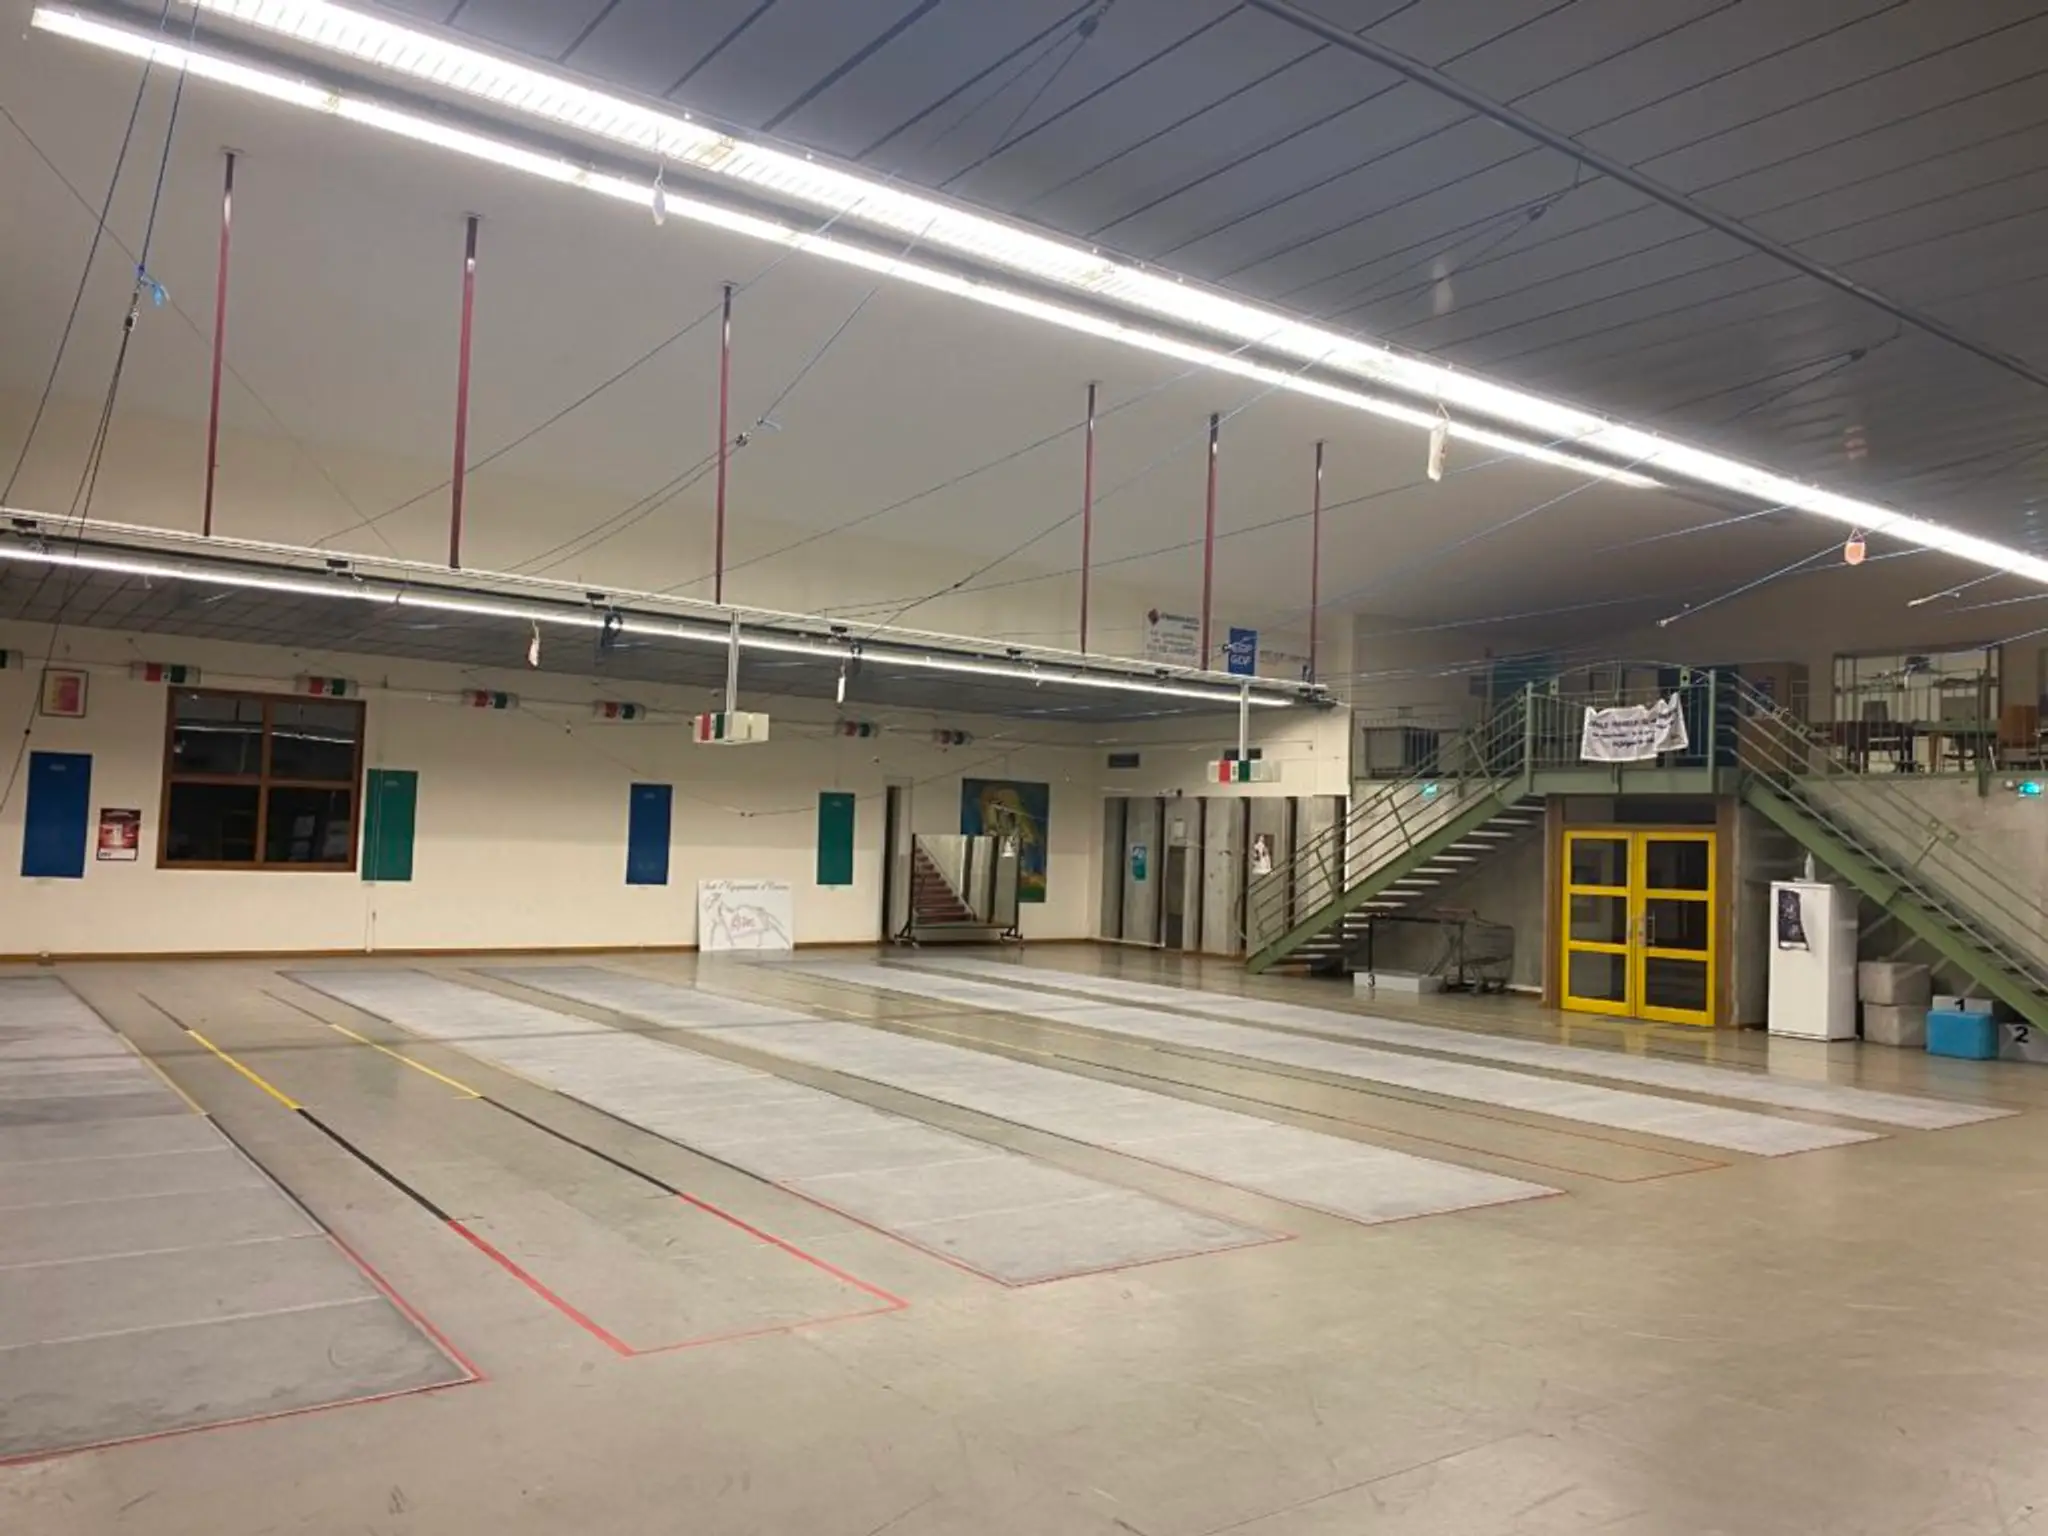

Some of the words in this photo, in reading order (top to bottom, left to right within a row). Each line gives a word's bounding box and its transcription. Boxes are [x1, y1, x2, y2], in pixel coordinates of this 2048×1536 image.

[1367, 974, 1375, 988] 3
[1955, 998, 1965, 1012] 1
[2014, 1026, 2029, 1043] 2
